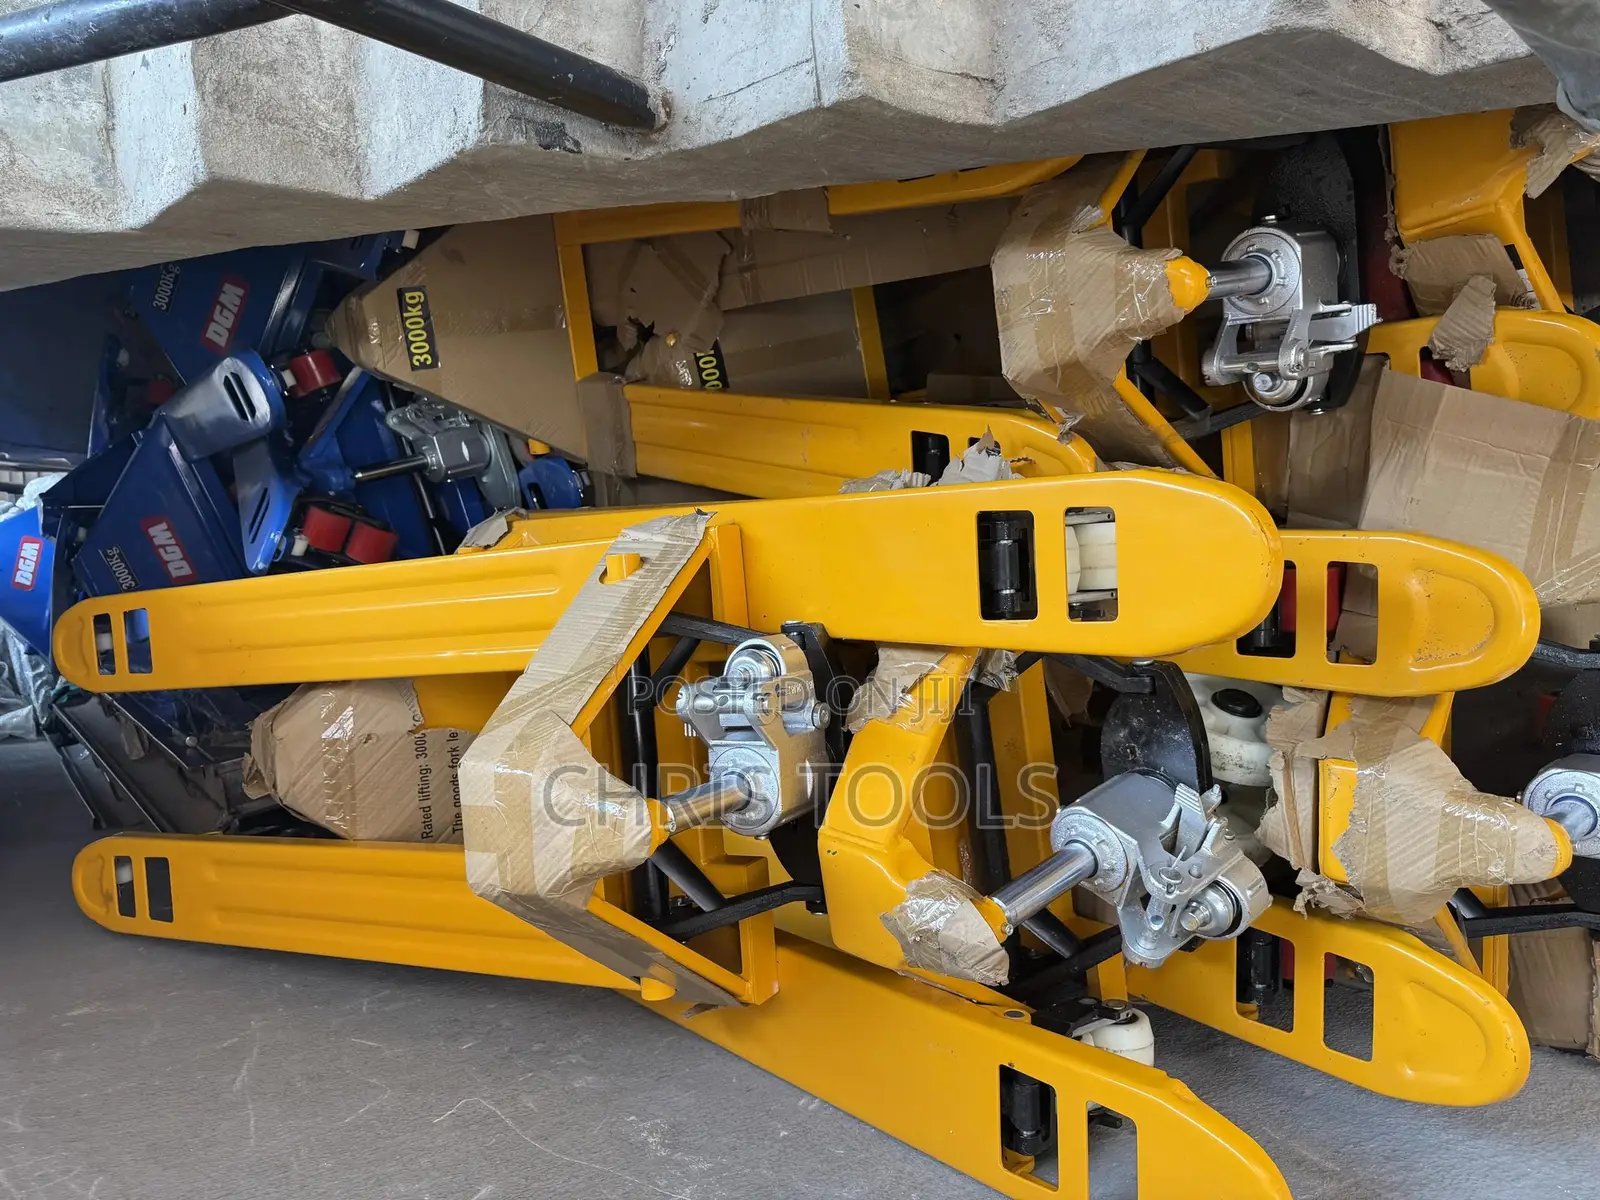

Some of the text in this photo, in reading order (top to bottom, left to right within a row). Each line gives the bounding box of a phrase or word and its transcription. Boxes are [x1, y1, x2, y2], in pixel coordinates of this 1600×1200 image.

[205, 282, 245, 348] DGM
[403, 291, 432, 367] 3000kg
[14, 542, 40, 586] DGM
[147, 521, 192, 579] DGM
[446, 729, 459, 742] le
[447, 746, 460, 769] fork
[417, 764, 432, 802] lifting:
[420, 805, 434, 840] Rated
[452, 812, 463, 835] The
